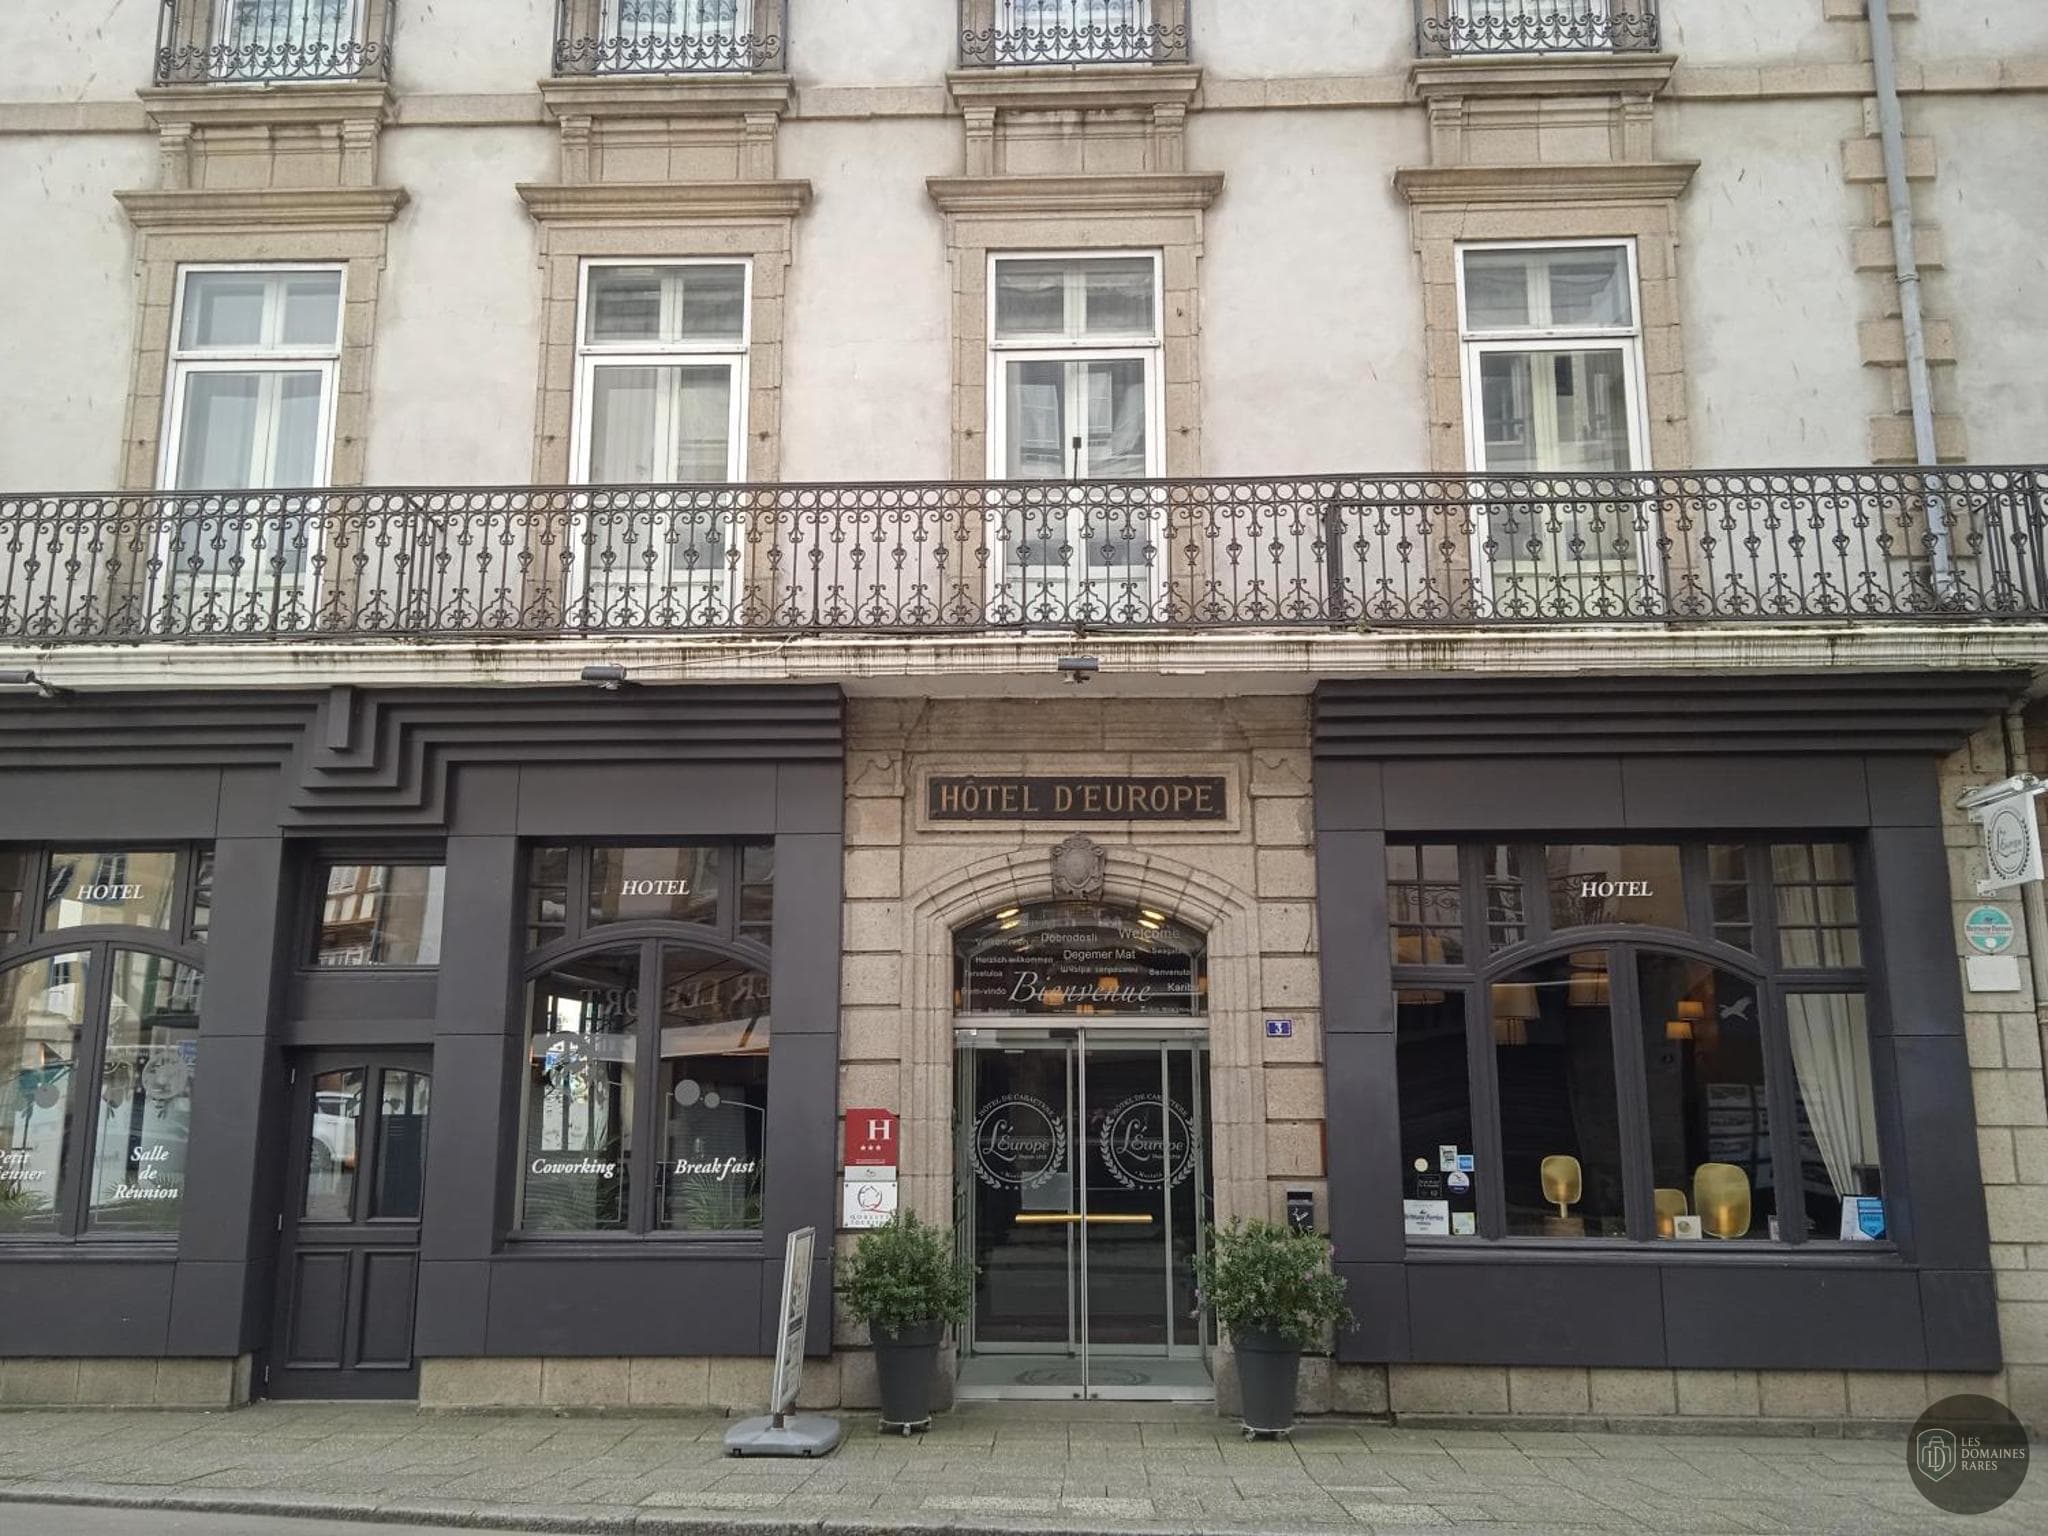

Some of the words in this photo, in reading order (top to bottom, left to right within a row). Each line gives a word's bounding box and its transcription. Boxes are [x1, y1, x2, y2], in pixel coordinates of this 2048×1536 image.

[941, 780, 1039, 812] HÔTEL
[1054, 784, 1213, 812] D'EUROPE
[77, 884, 144, 899] HOTEL
[621, 880, 690, 895] HOTEL
[1580, 881, 1654, 898] HOTEL
[1119, 927, 1180, 939] Welcome
[1115, 949, 1136, 960] Mat
[1008, 970, 1152, 1003] Bienvenue
[868, 1119, 892, 1140] H
[130, 1146, 169, 1161] Salle
[138, 1165, 157, 1180] de
[531, 1158, 616, 1178] Coworking
[674, 1157, 755, 1181] Breakfast
[115, 1184, 178, 1199] Réunion
